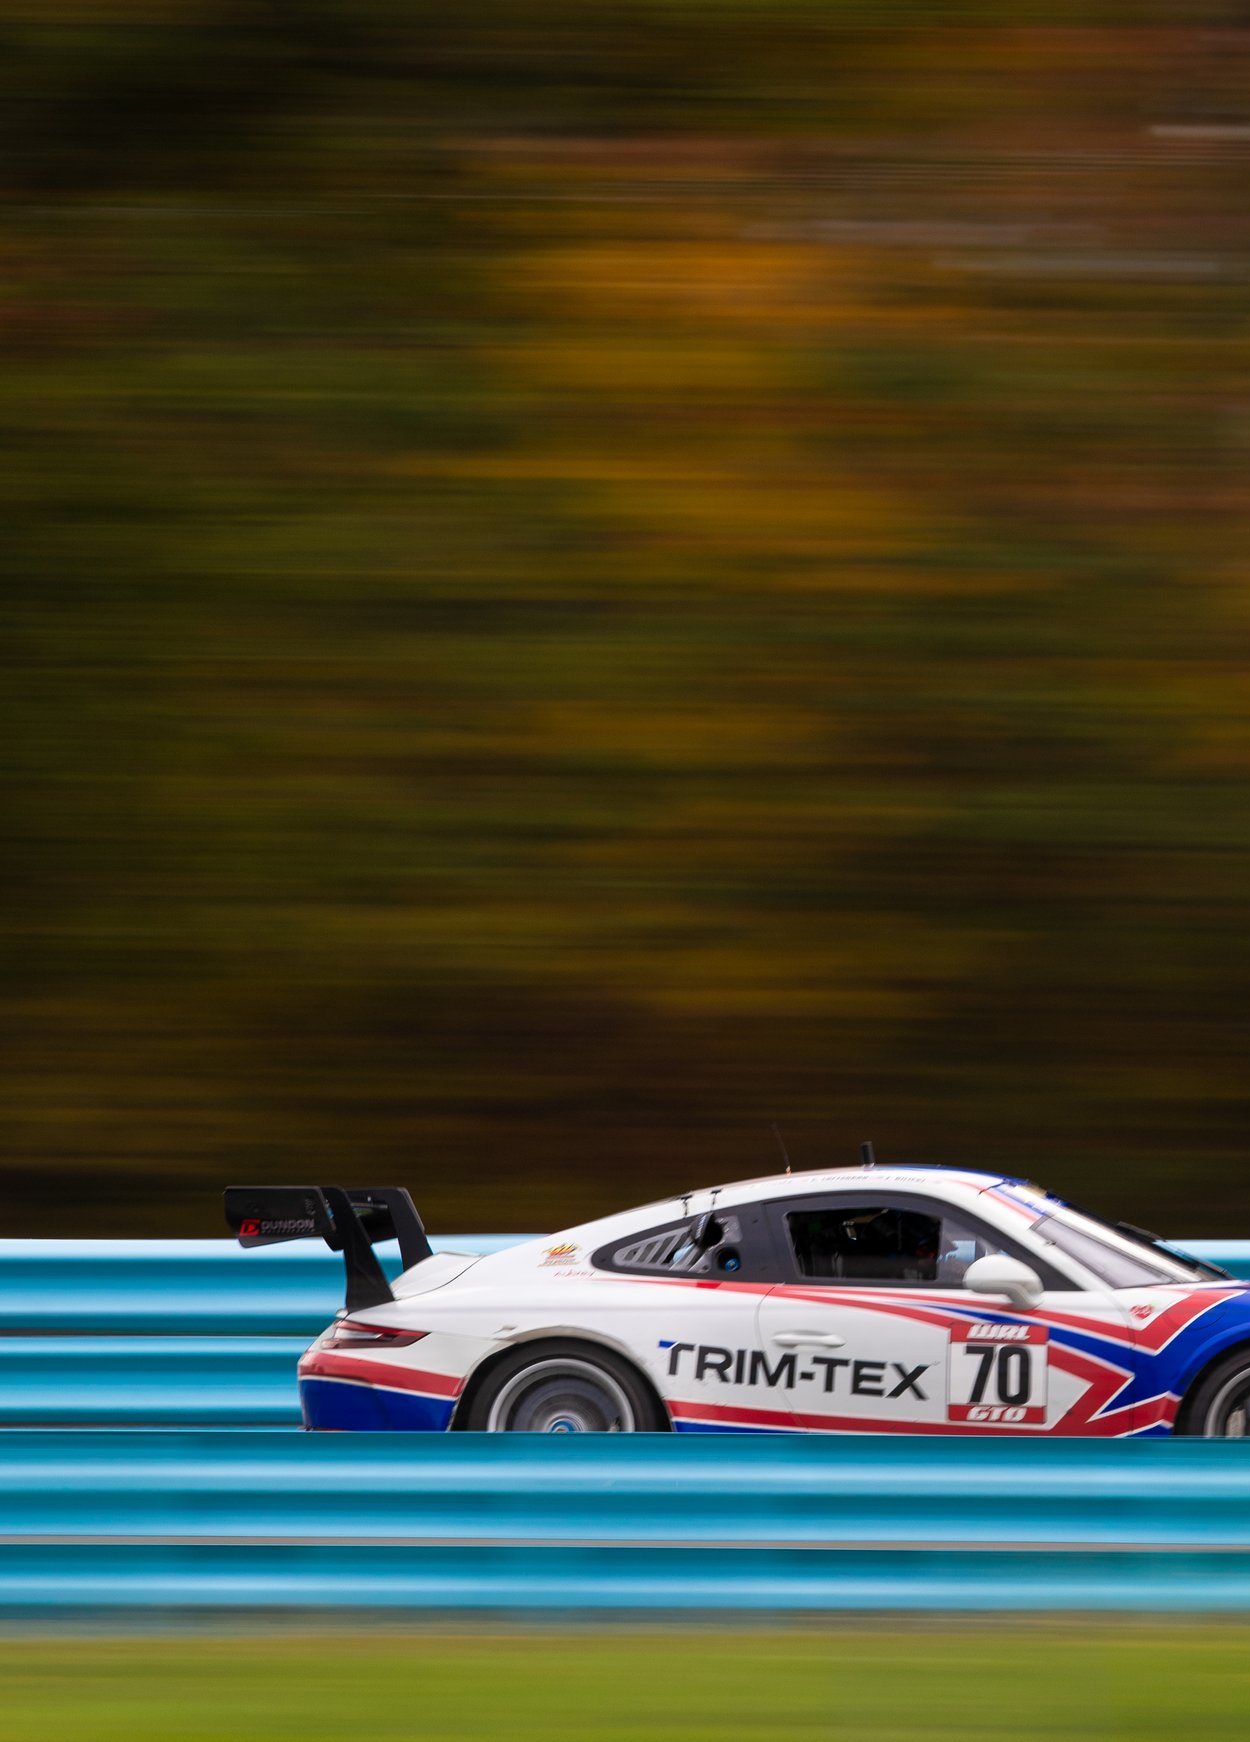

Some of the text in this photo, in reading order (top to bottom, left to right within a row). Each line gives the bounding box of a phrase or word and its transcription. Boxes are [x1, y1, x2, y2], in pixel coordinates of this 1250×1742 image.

[261, 1219, 315, 1230] DUNDON
[966, 1324, 1031, 1340] WRL
[658, 1340, 931, 1401] TRIM-TEX
[965, 1344, 1030, 1405] 70
[966, 1406, 1028, 1422] GTO
